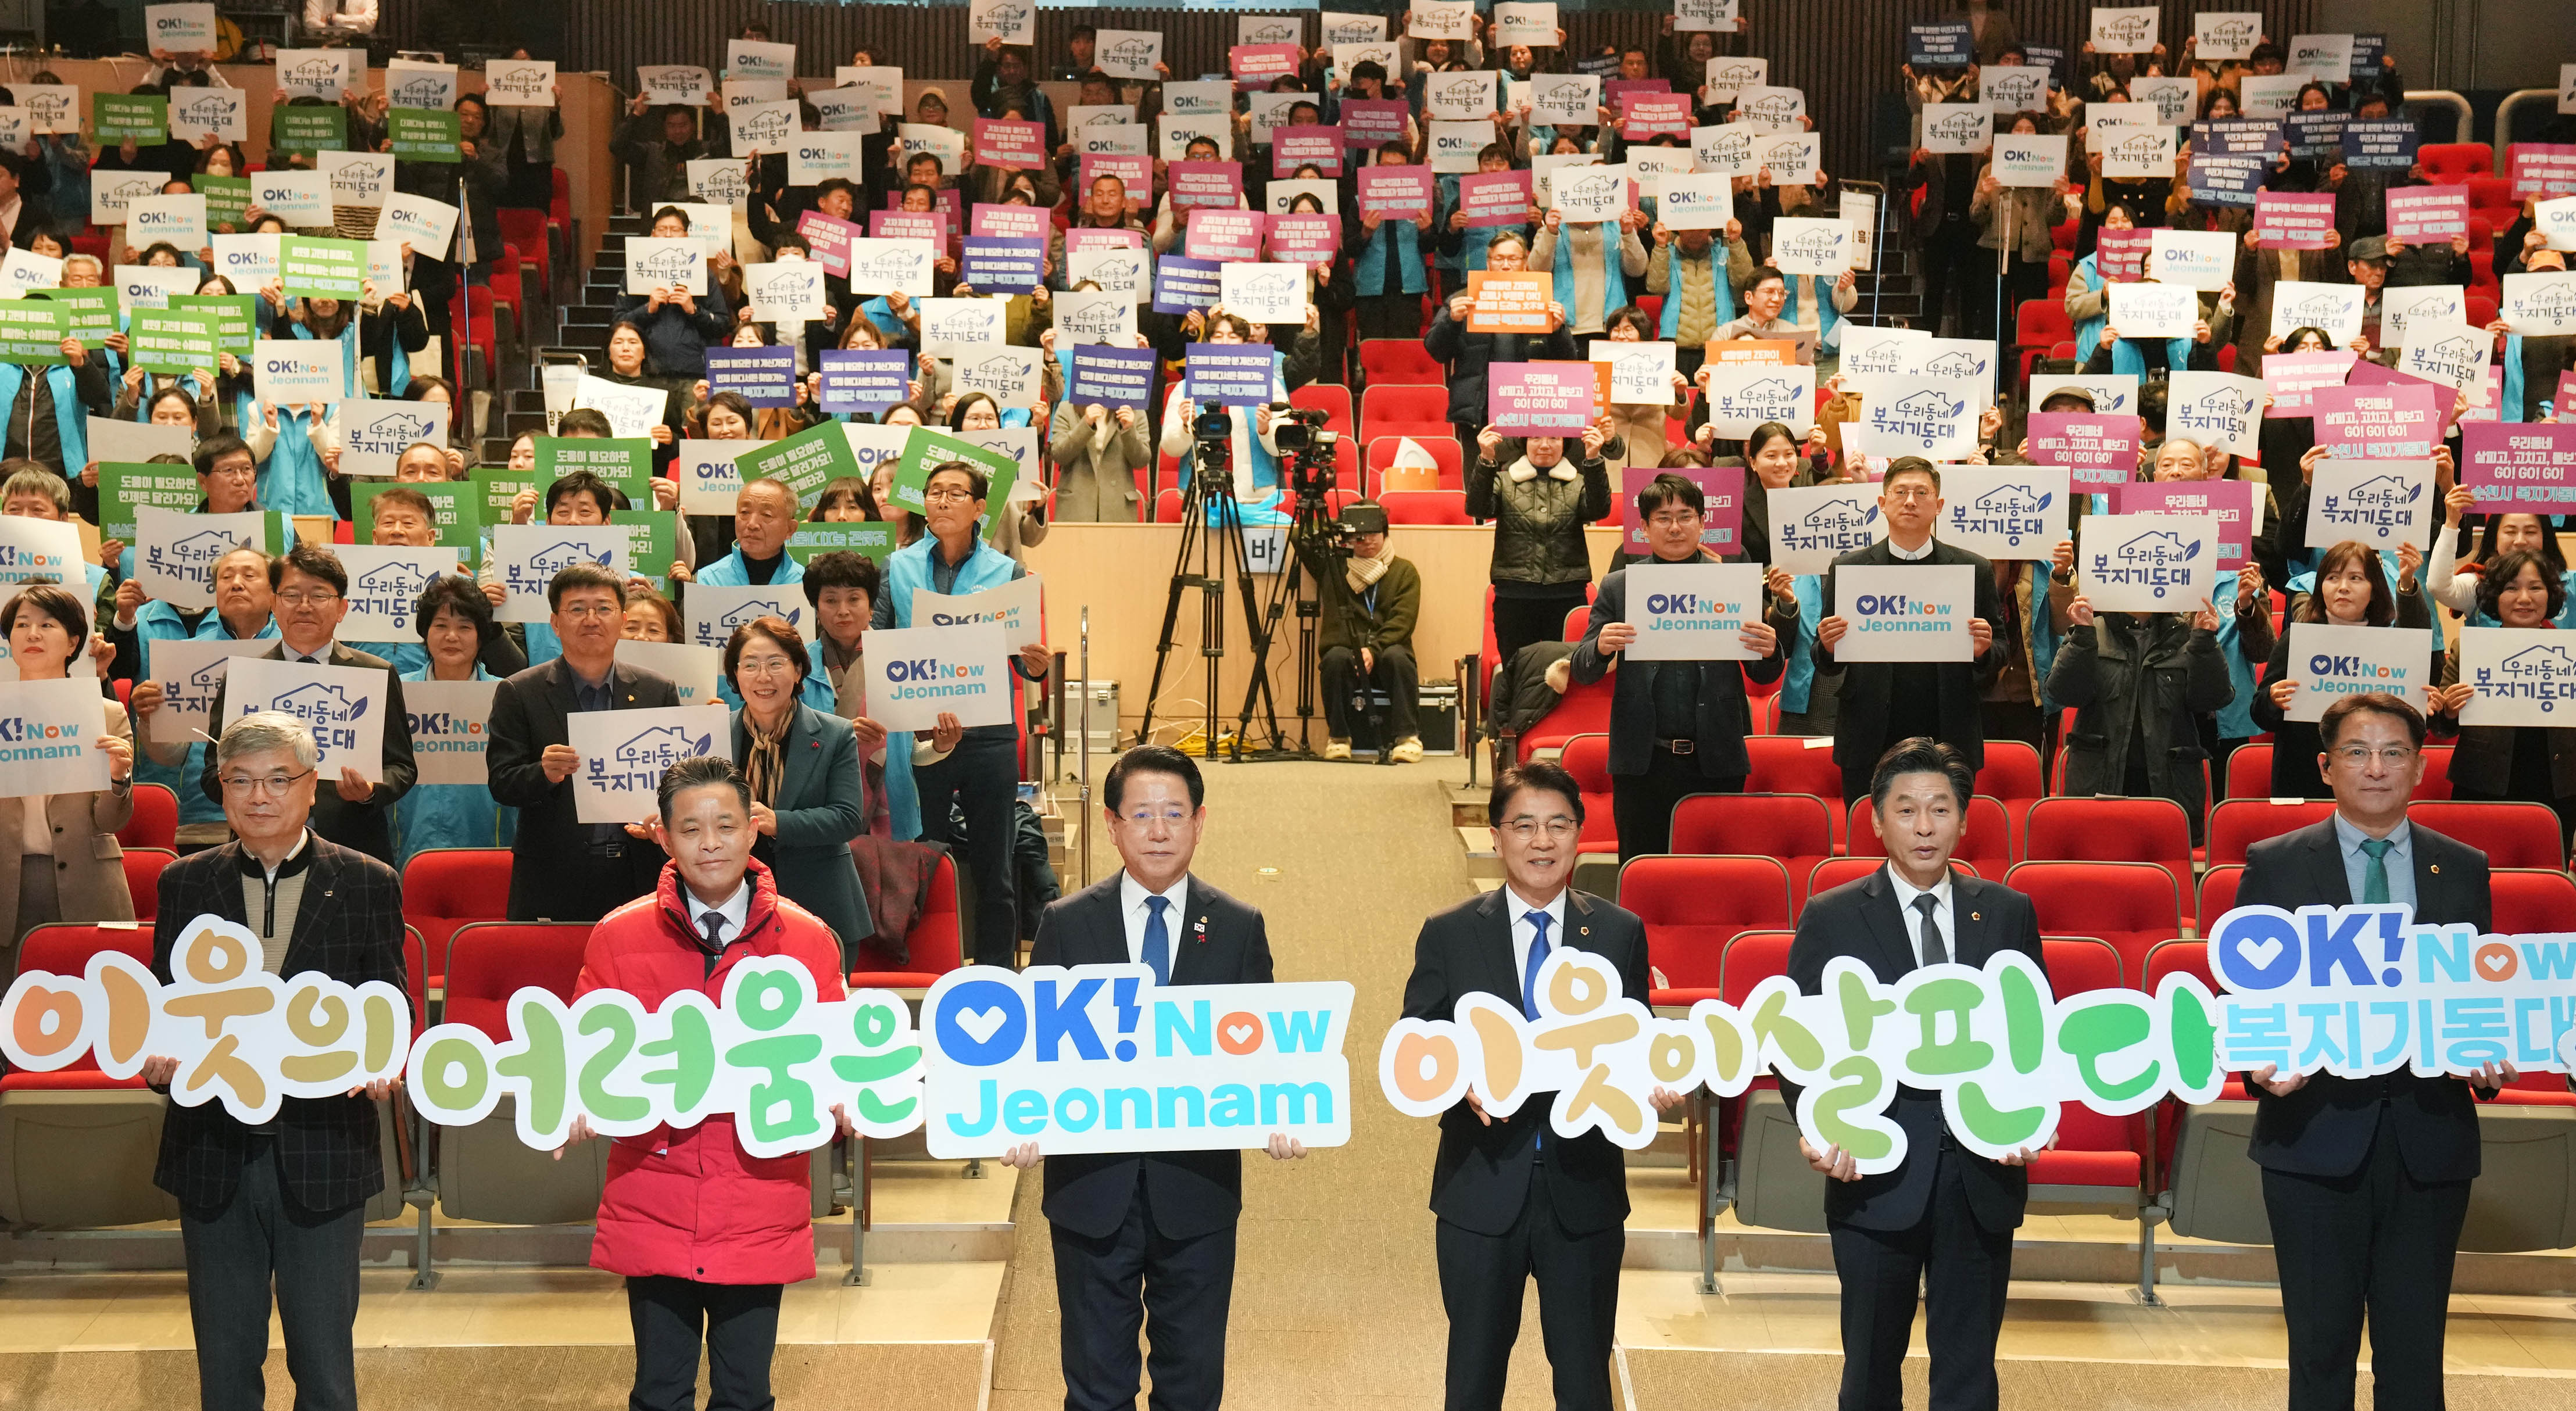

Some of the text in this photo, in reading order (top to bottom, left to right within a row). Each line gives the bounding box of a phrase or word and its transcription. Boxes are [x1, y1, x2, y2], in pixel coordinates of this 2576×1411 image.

[191, 103, 229, 118] 우리동네
[180, 108, 232, 133] 복지기동대
[800, 148, 850, 160] OK! Now
[2109, 146, 2162, 170] 복지기동대
[1574, 182, 1610, 195] 우리동네
[1669, 191, 1722, 203] OK! Now
[1558, 191, 1615, 214] 복지기동대
[1670, 204, 1723, 213] Jeonnam
[139, 213, 194, 224] OK! Now
[1797, 235, 1833, 248] 우리동네
[1780, 239, 1837, 267] 복지기동대
[2165, 249, 2221, 264] OK! Now
[653, 257, 687, 269] 우리동네
[876, 257, 913, 270] 우리동네
[2165, 264, 2221, 274] Jeonnam
[634, 262, 692, 287] 복지기동대
[860, 262, 917, 288] 복지기동대
[770, 280, 806, 293] 우리동네
[1247, 281, 1286, 294] 우리동네
[756, 288, 811, 312] 복지기동대
[1230, 288, 1290, 314] 복지기동대
[2139, 298, 2176, 309] 우리동네
[2534, 292, 2574, 305] 우리동네
[1079, 310, 1116, 322] 우리동네
[2118, 302, 2182, 328] 복지기동대
[2303, 303, 2341, 316] 우리동네
[2412, 305, 2448, 317] 우리동네
[947, 317, 986, 329] 우리동네
[1062, 315, 1121, 342] 복지기동대
[2438, 345, 2475, 364] 우리동네
[267, 360, 328, 374] OK! Now
[982, 364, 1021, 378] 우리동네
[1614, 361, 1654, 374] 우리동네
[1928, 363, 1974, 378] 우리동네
[2411, 347, 2475, 388] 복지기동대
[269, 374, 330, 385] Jeonnam
[961, 367, 1024, 399] 복지기동대
[1524, 373, 1558, 385] 우리동네
[1514, 397, 1568, 410] GO! GO! GO!
[1745, 390, 1790, 405] 우리동네
[2354, 398, 2393, 410] 우리동네
[1897, 402, 1949, 422] 우리동네
[2203, 399, 2244, 416] 우리동네
[1531, 413, 1585, 428] 복지기동대
[1871, 407, 1955, 449] 복지기동대
[2178, 404, 2247, 442] 복지기동대
[373, 424, 420, 438] 우리동네
[2066, 425, 2103, 437] 우리동네
[2344, 424, 2407, 438] GO! GO! GO!
[2325, 442, 2431, 460] 순천시 복지기동대
[2509, 436, 2553, 450] 우리동네
[557, 450, 586, 463] 도움이
[858, 447, 897, 465] OK!
[2055, 450, 2113, 464] GO! GO! GO!
[2551, 452, 2576, 465] 돌보
[697, 463, 735, 480] OK!
[2073, 468, 2128, 484] 복지기동대
[2494, 466, 2564, 481] GO! GO! GO!
[120, 476, 196, 490] 도움이 필요하면
[119, 490, 199, 506] 언제든 달려가요!
[2165, 495, 2208, 508] 우리동네
[2352, 489, 2407, 508] 우리동네
[2471, 486, 2513, 502] 순천시
[1983, 500, 2035, 517] 우리동네
[2321, 496, 2413, 538] 복지기동대
[1811, 512, 1863, 531] 우리동네
[1951, 506, 2043, 547] 복지기동대
[1781, 524, 1872, 556] 복지기동대
[19, 552, 63, 566] Now
[181, 545, 226, 563] 우리동
[1251, 538, 1276, 564] 바
[2126, 546, 2183, 566] 우리동네
[146, 546, 217, 593] 복지기동
[2092, 554, 2191, 599] 복지기동대
[366, 576, 422, 594] 우리동네
[1647, 594, 1741, 614] OK! Now
[1856, 595, 1952, 615] OK! Now
[982, 606, 1019, 622] Now
[1648, 617, 1741, 631] Jeonnam
[1858, 619, 1952, 632] Jeonnam
[886, 658, 985, 682] OK! Now
[2310, 654, 2407, 679] OK! Now
[2510, 660, 2571, 679] 우리동네
[890, 682, 986, 700] Jeonnam
[2310, 678, 2406, 696] Jeonnam
[280, 700, 348, 725] 우리동네
[0, 717, 79, 742] K! Now
[0, 743, 81, 762] onnam
[413, 738, 488, 753] eonna
[624, 743, 692, 768] 우리동네
[2219, 913, 2576, 990] OK! Now
[13, 929, 395, 1109] 이웃의
[935, 977, 1332, 1066] OK! Now
[2224, 996, 2576, 1072] 복지기동대
[422, 970, 923, 1143] 어려움은
[1394, 962, 1743, 1134] 이웃이
[1751, 965, 2217, 1159] 살핀다
[946, 1079, 1333, 1137] Jeonnam
